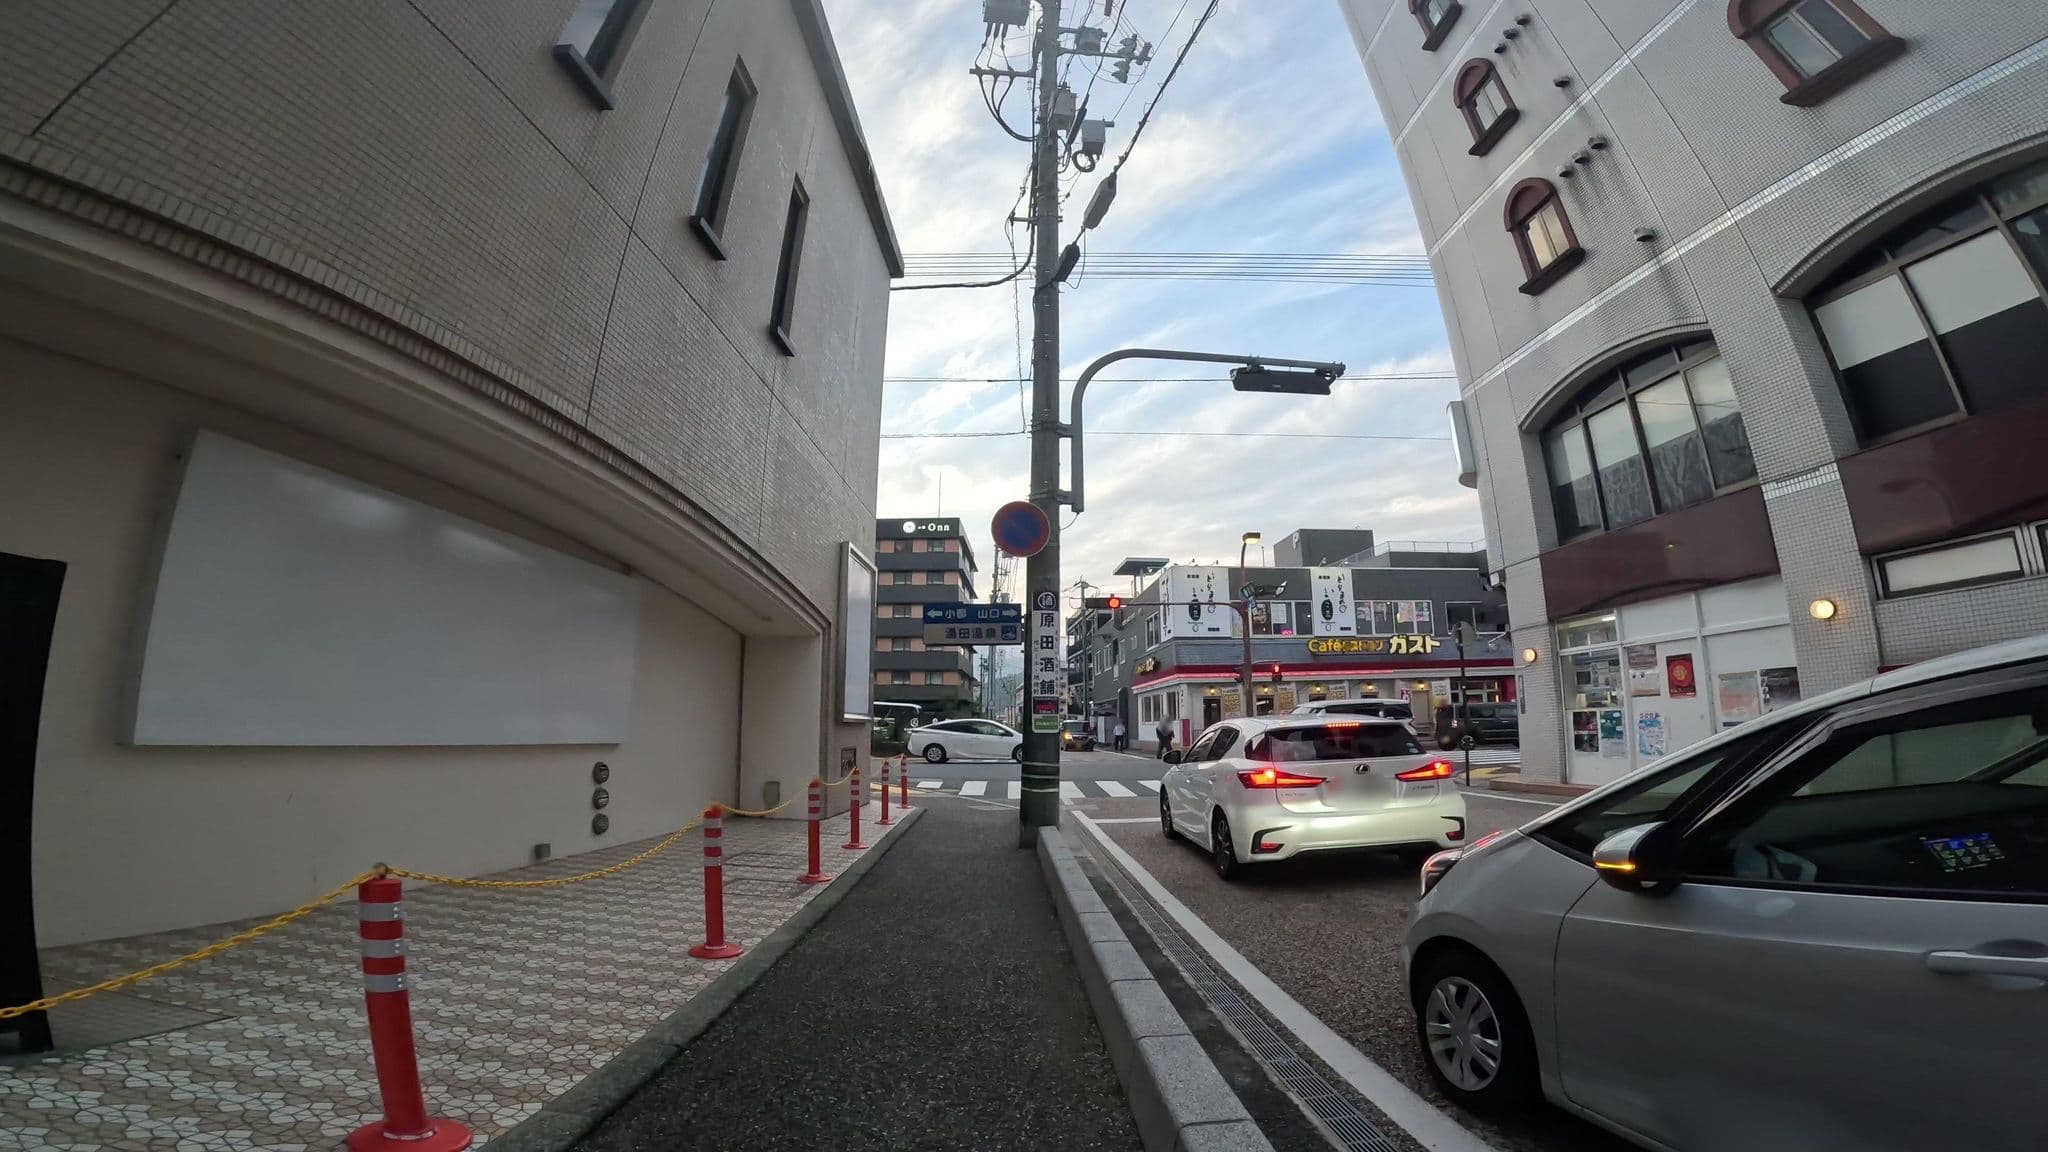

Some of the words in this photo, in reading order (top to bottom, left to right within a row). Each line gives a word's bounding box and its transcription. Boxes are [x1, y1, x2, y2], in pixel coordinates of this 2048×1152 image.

[928, 522, 950, 532] Onn
[978, 608, 1000, 619] 山口
[1389, 635, 1441, 654] ガスト
